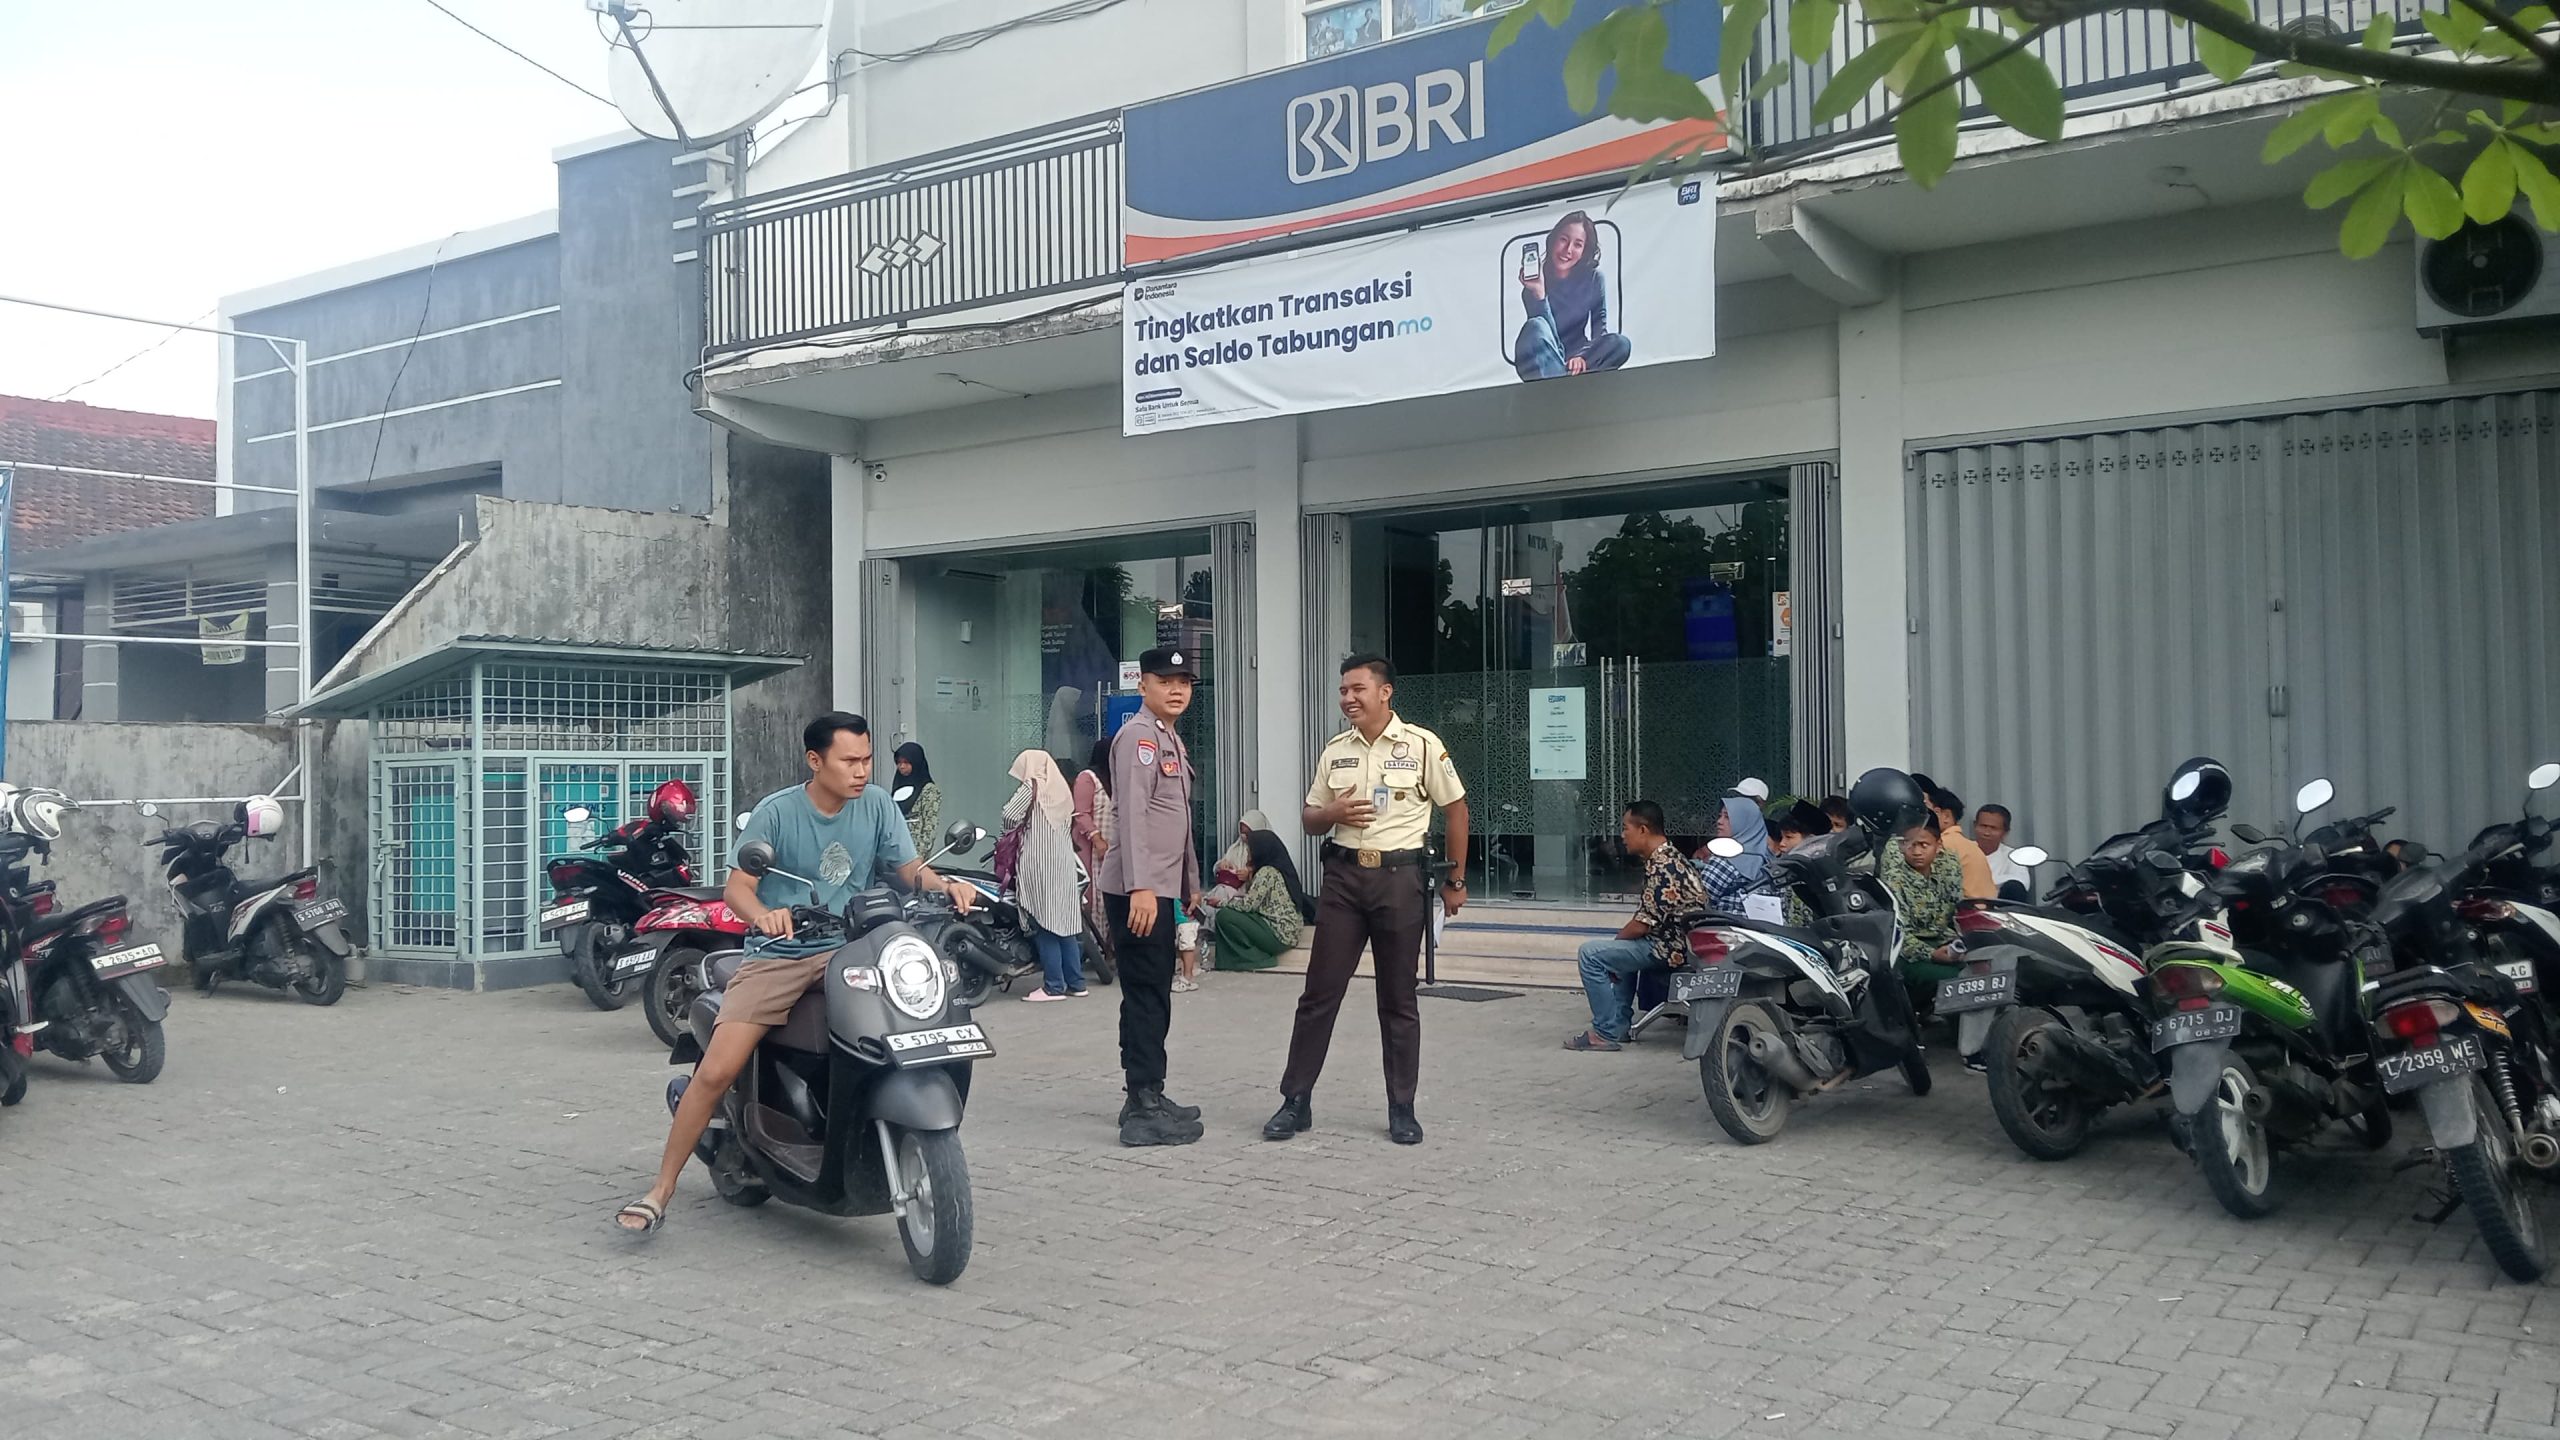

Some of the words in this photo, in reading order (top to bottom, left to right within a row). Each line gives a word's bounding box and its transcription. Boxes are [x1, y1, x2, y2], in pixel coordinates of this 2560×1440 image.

[1364, 60, 1485, 163] BRI
[1681, 185, 1697, 196] BRI
[1134, 301, 1273, 343] Tingkatkan
[1278, 270, 1412, 318] Transaksi
[1144, 290, 1175, 301] Indonesia
[1135, 352, 1180, 377] dan
[1184, 339, 1253, 369] Saldo
[297, 914, 305, 922] S
[96, 959, 105, 968] S
[109, 951, 135, 966] 2635
[1675, 976, 1682, 988] S
[1723, 972, 1736, 984] IV
[2510, 965, 2527, 977] AG
[1944, 985, 1954, 998] S
[1958, 979, 1985, 995] 6399
[1992, 975, 2007, 989] BJ
[2156, 1023, 2163, 1036] S
[2169, 1013, 2204, 1029] 6715
[2215, 1009, 2233, 1023] DJ
[894, 1037, 905, 1049] S
[911, 1031, 948, 1047] 5795
[956, 1027, 976, 1040] CX
[2405, 1048, 2445, 1072] 2359
[2449, 1040, 2476, 1060] WE
